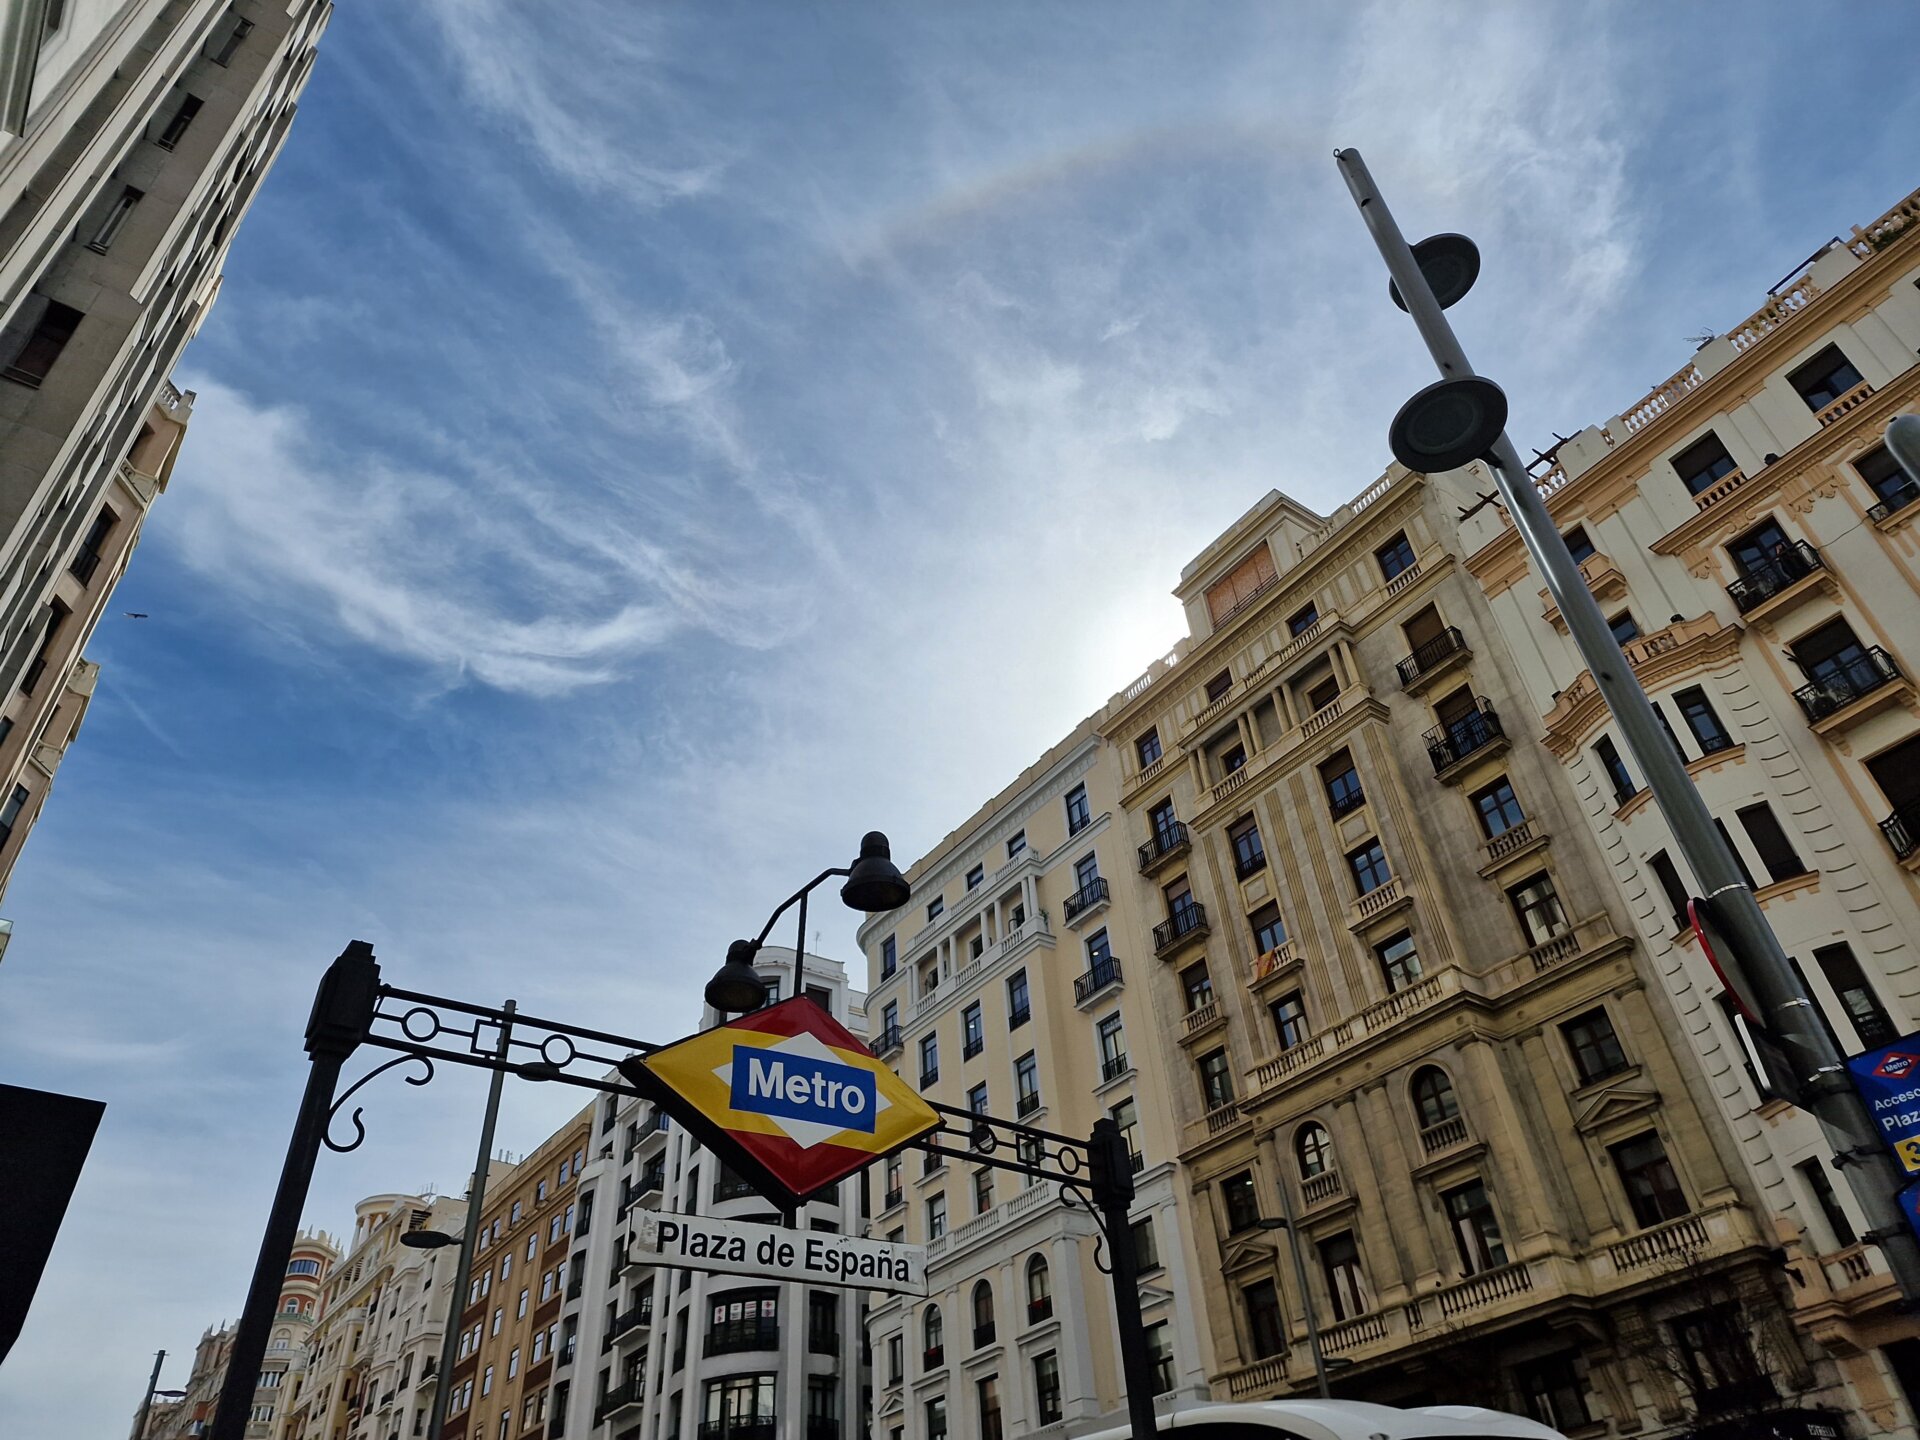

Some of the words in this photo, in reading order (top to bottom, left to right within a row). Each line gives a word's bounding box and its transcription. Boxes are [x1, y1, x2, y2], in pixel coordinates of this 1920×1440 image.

[1884, 1060, 1909, 1073] Metro
[748, 1058, 866, 1115] Metro
[1881, 1110, 1920, 1131] Plaz
[656, 1220, 746, 1263] Plaza
[757, 1233, 795, 1268] de
[804, 1238, 910, 1283] España
